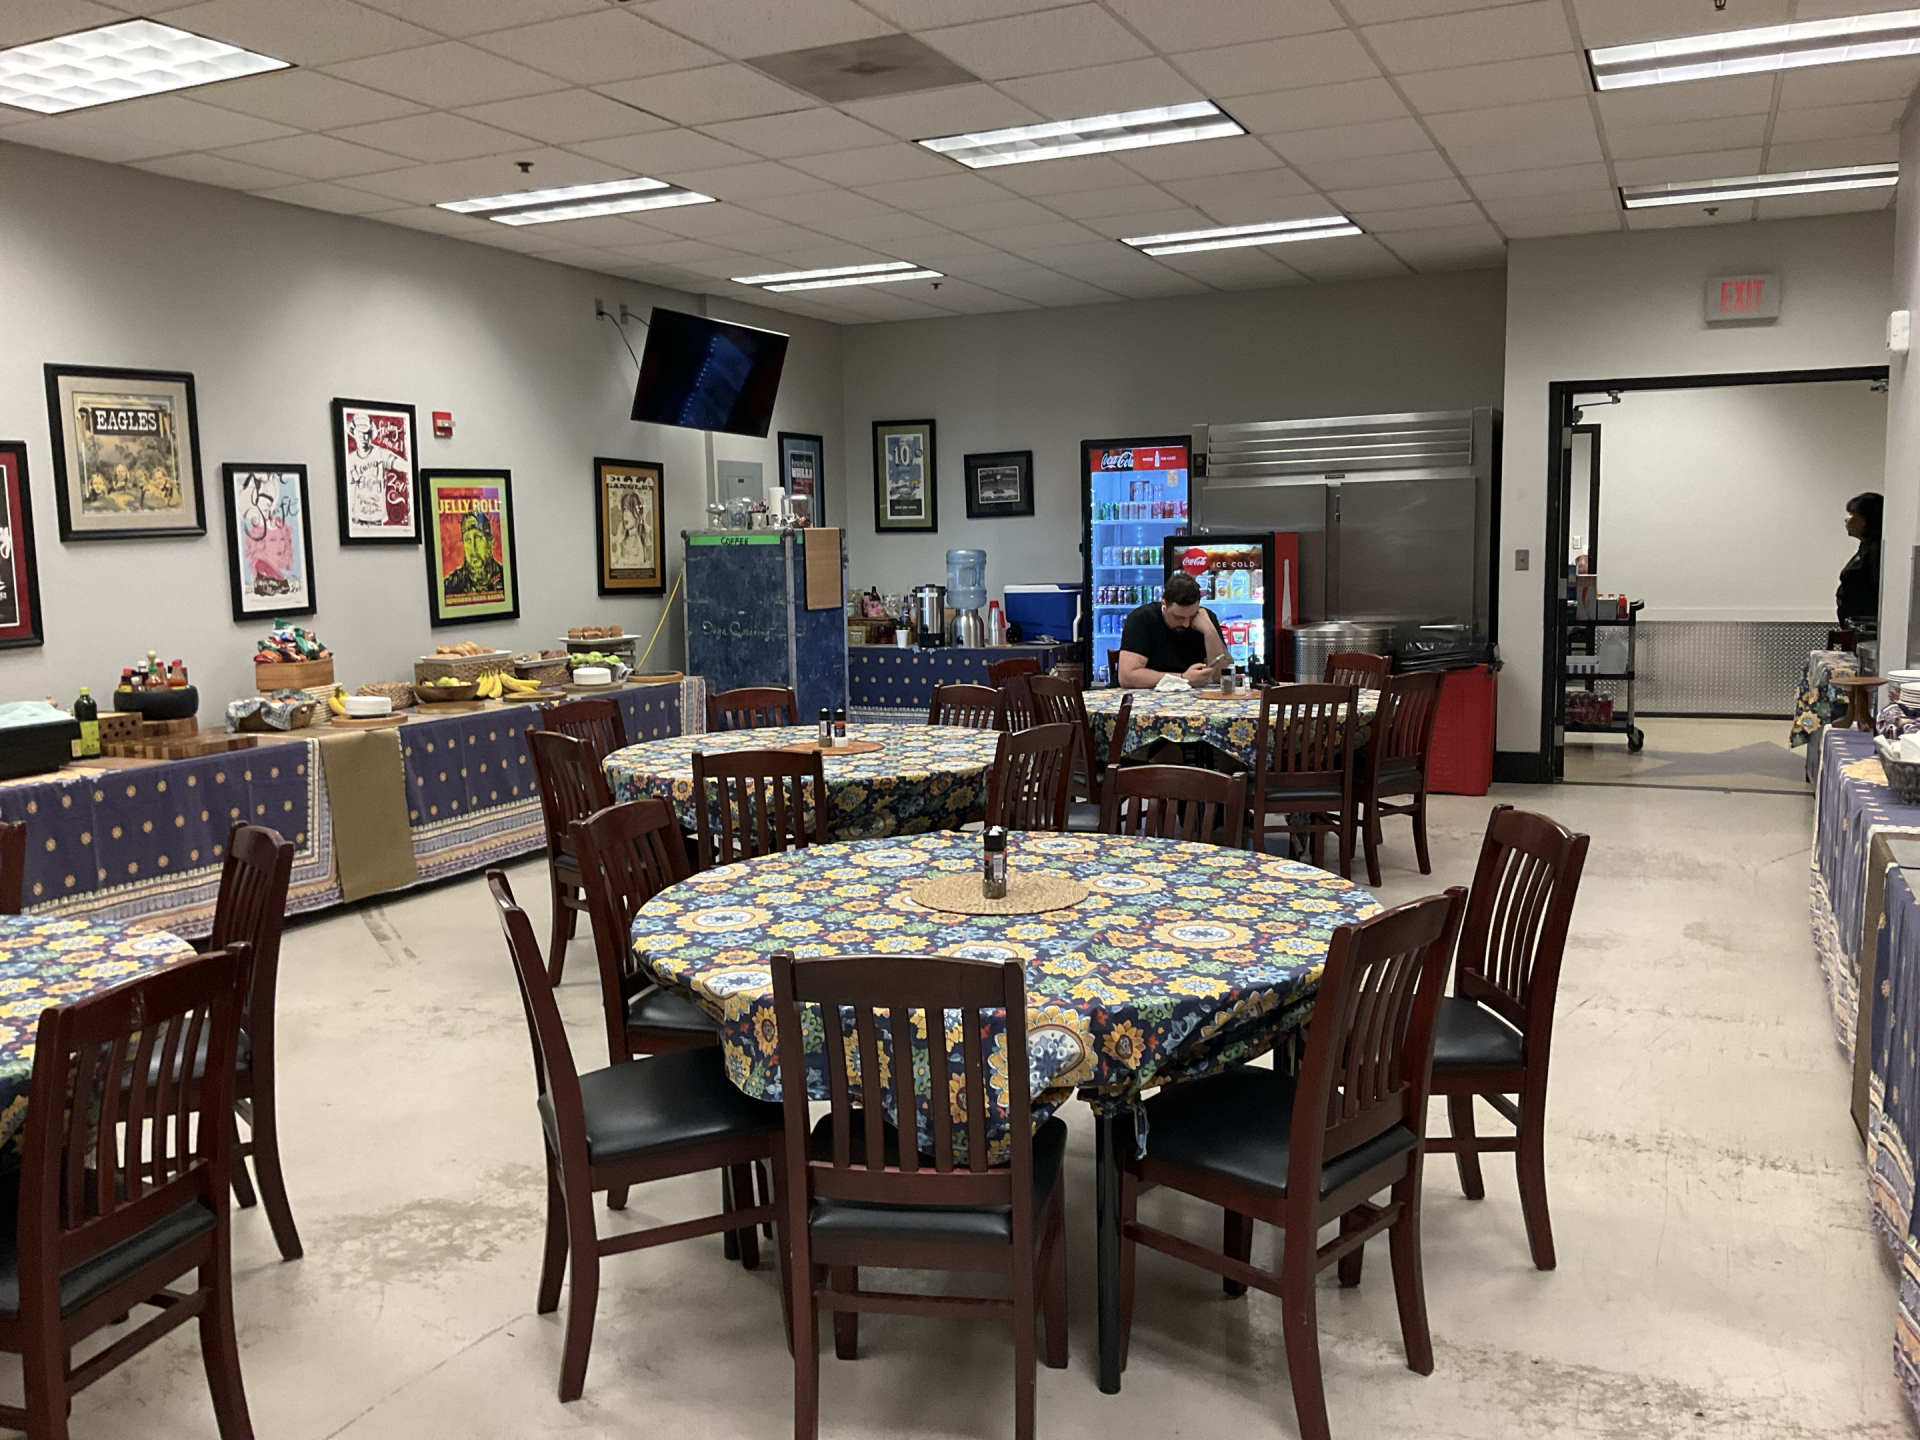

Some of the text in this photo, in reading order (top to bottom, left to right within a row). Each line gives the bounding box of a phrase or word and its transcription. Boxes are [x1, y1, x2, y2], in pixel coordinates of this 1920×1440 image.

[1720, 280, 1765, 313] EXIT
[95, 408, 158, 433] EAGLES
[893, 444, 910, 466] 10
[606, 483, 655, 491] LANGLEY
[438, 498, 500, 514] JELLY ROLL
[720, 536, 749, 545] COFFEE
[1182, 556, 1207, 566] Coca-Cola
